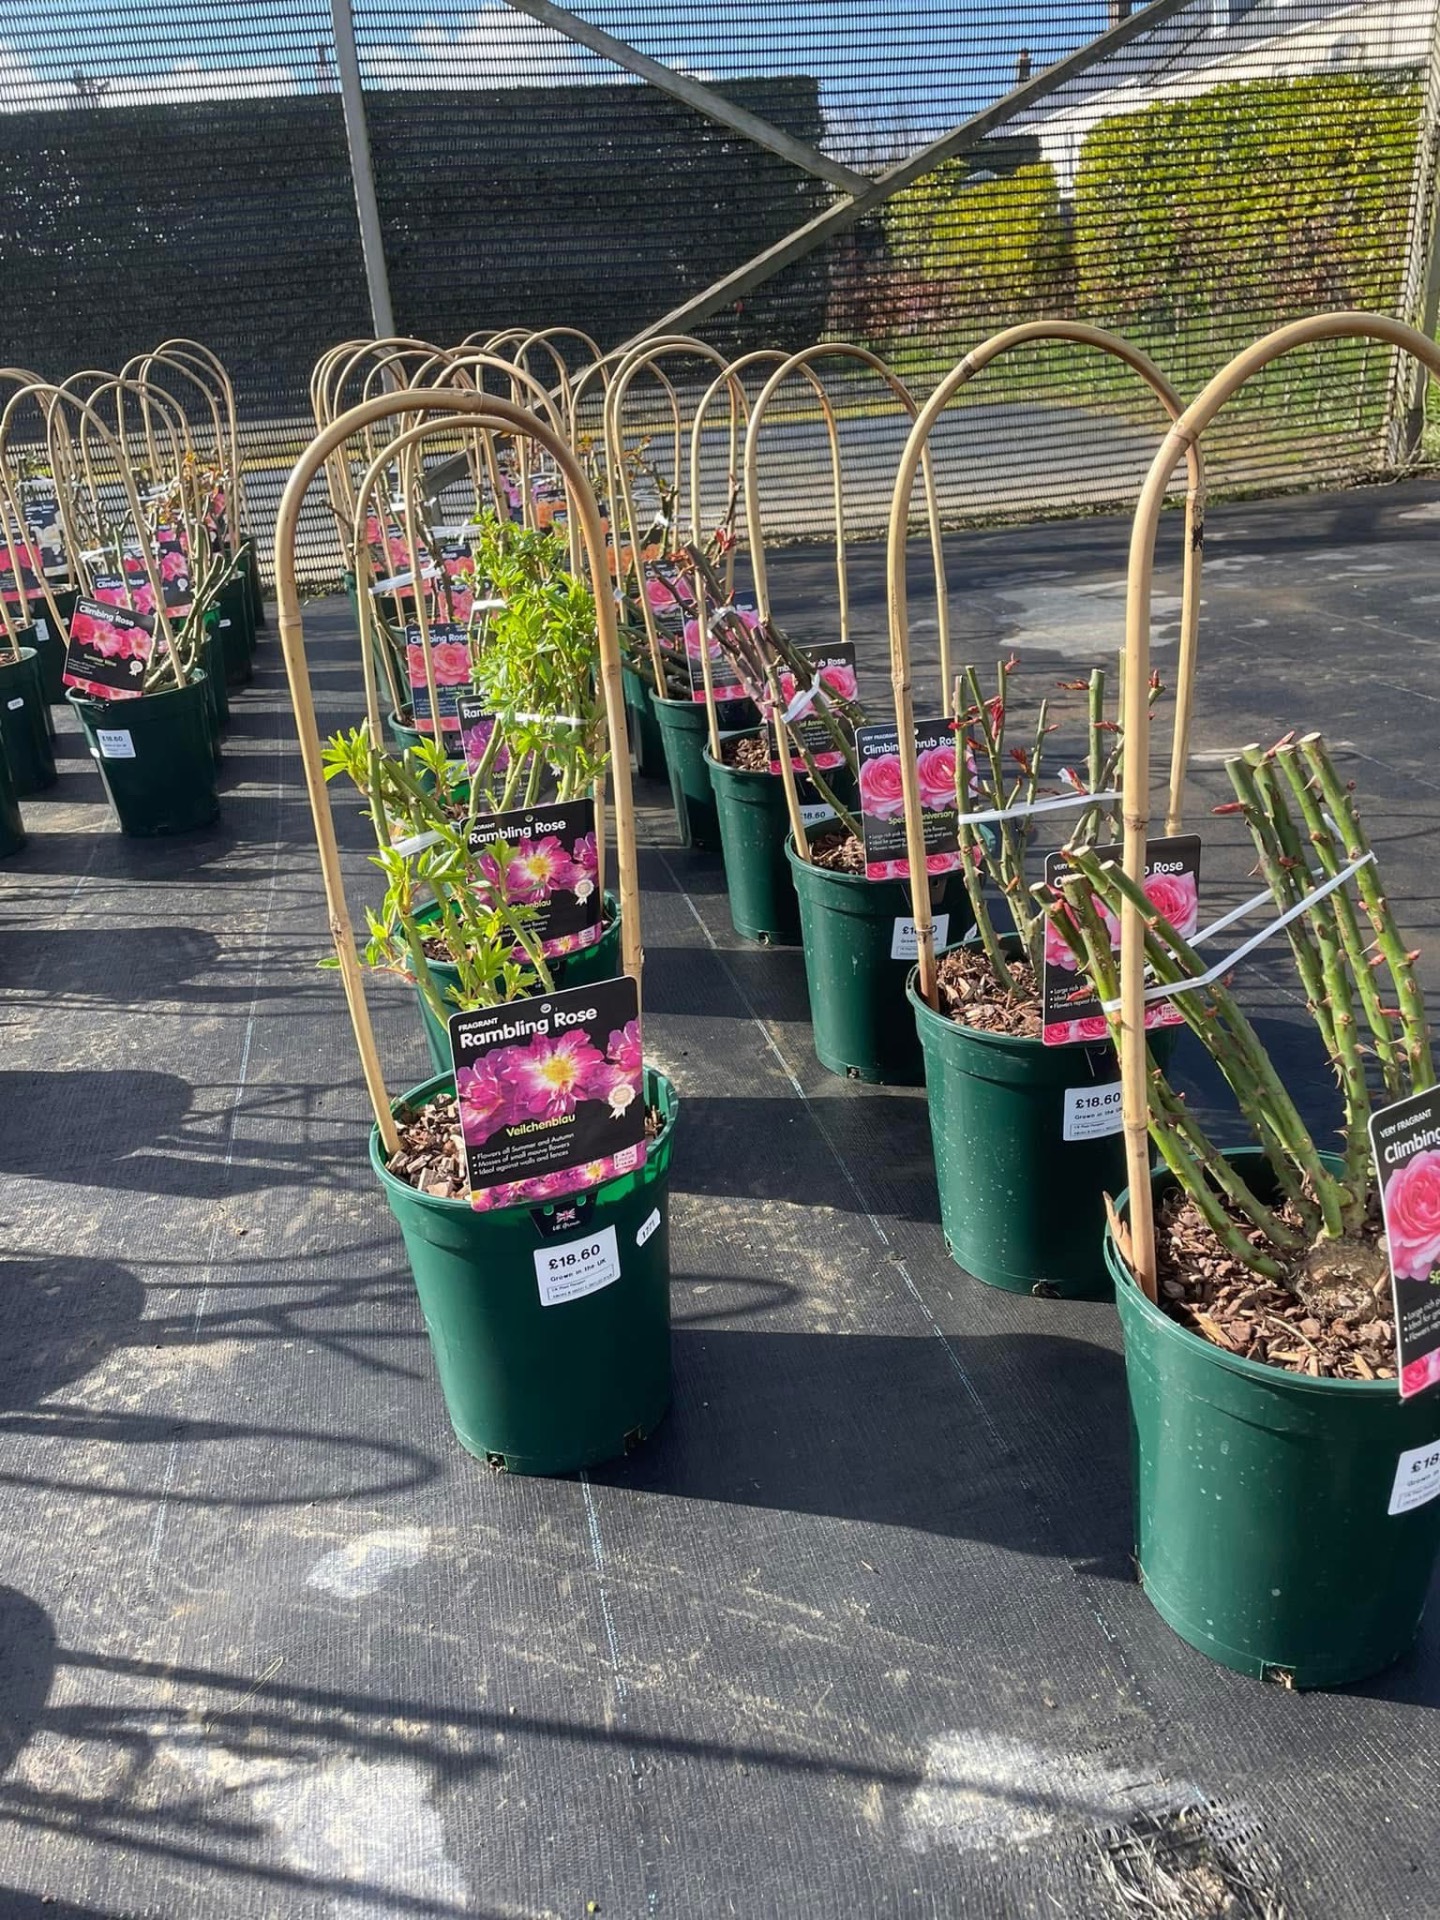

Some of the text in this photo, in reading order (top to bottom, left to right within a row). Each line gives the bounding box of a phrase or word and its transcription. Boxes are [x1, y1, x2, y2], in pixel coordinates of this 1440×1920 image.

[863, 736, 957, 755] Climbin hrub Ros
[468, 820, 566, 844] Rambling Rose
[1153, 861, 1184, 873] Rose
[458, 1017, 498, 1031] FRAGRANT
[460, 1008, 598, 1048] Rambling Rose
[1075, 1092, 1120, 1109] £18.60
[506, 1114, 576, 1137] Veilchenblau
[1380, 1108, 1432, 1138] VERY FRAGRANT
[477, 1150, 501, 1160] Flowers
[512, 1142, 536, 1152] Summer
[538, 1138, 550, 1147] and
[551, 1133, 574, 1142] Autumn
[478, 1158, 501, 1168] Masses
[502, 1154, 510, 1162] of
[510, 1150, 526, 1160] small
[548, 1142, 570, 1152] flowers
[479, 1166, 494, 1175] Ideal
[496, 1162, 519, 1172] against
[536, 1154, 549, 1162] and
[550, 1150, 569, 1160] fences
[548, 1244, 600, 1270] £18.60
[550, 1272, 574, 1282] Grown
[584, 1264, 595, 1272] the
